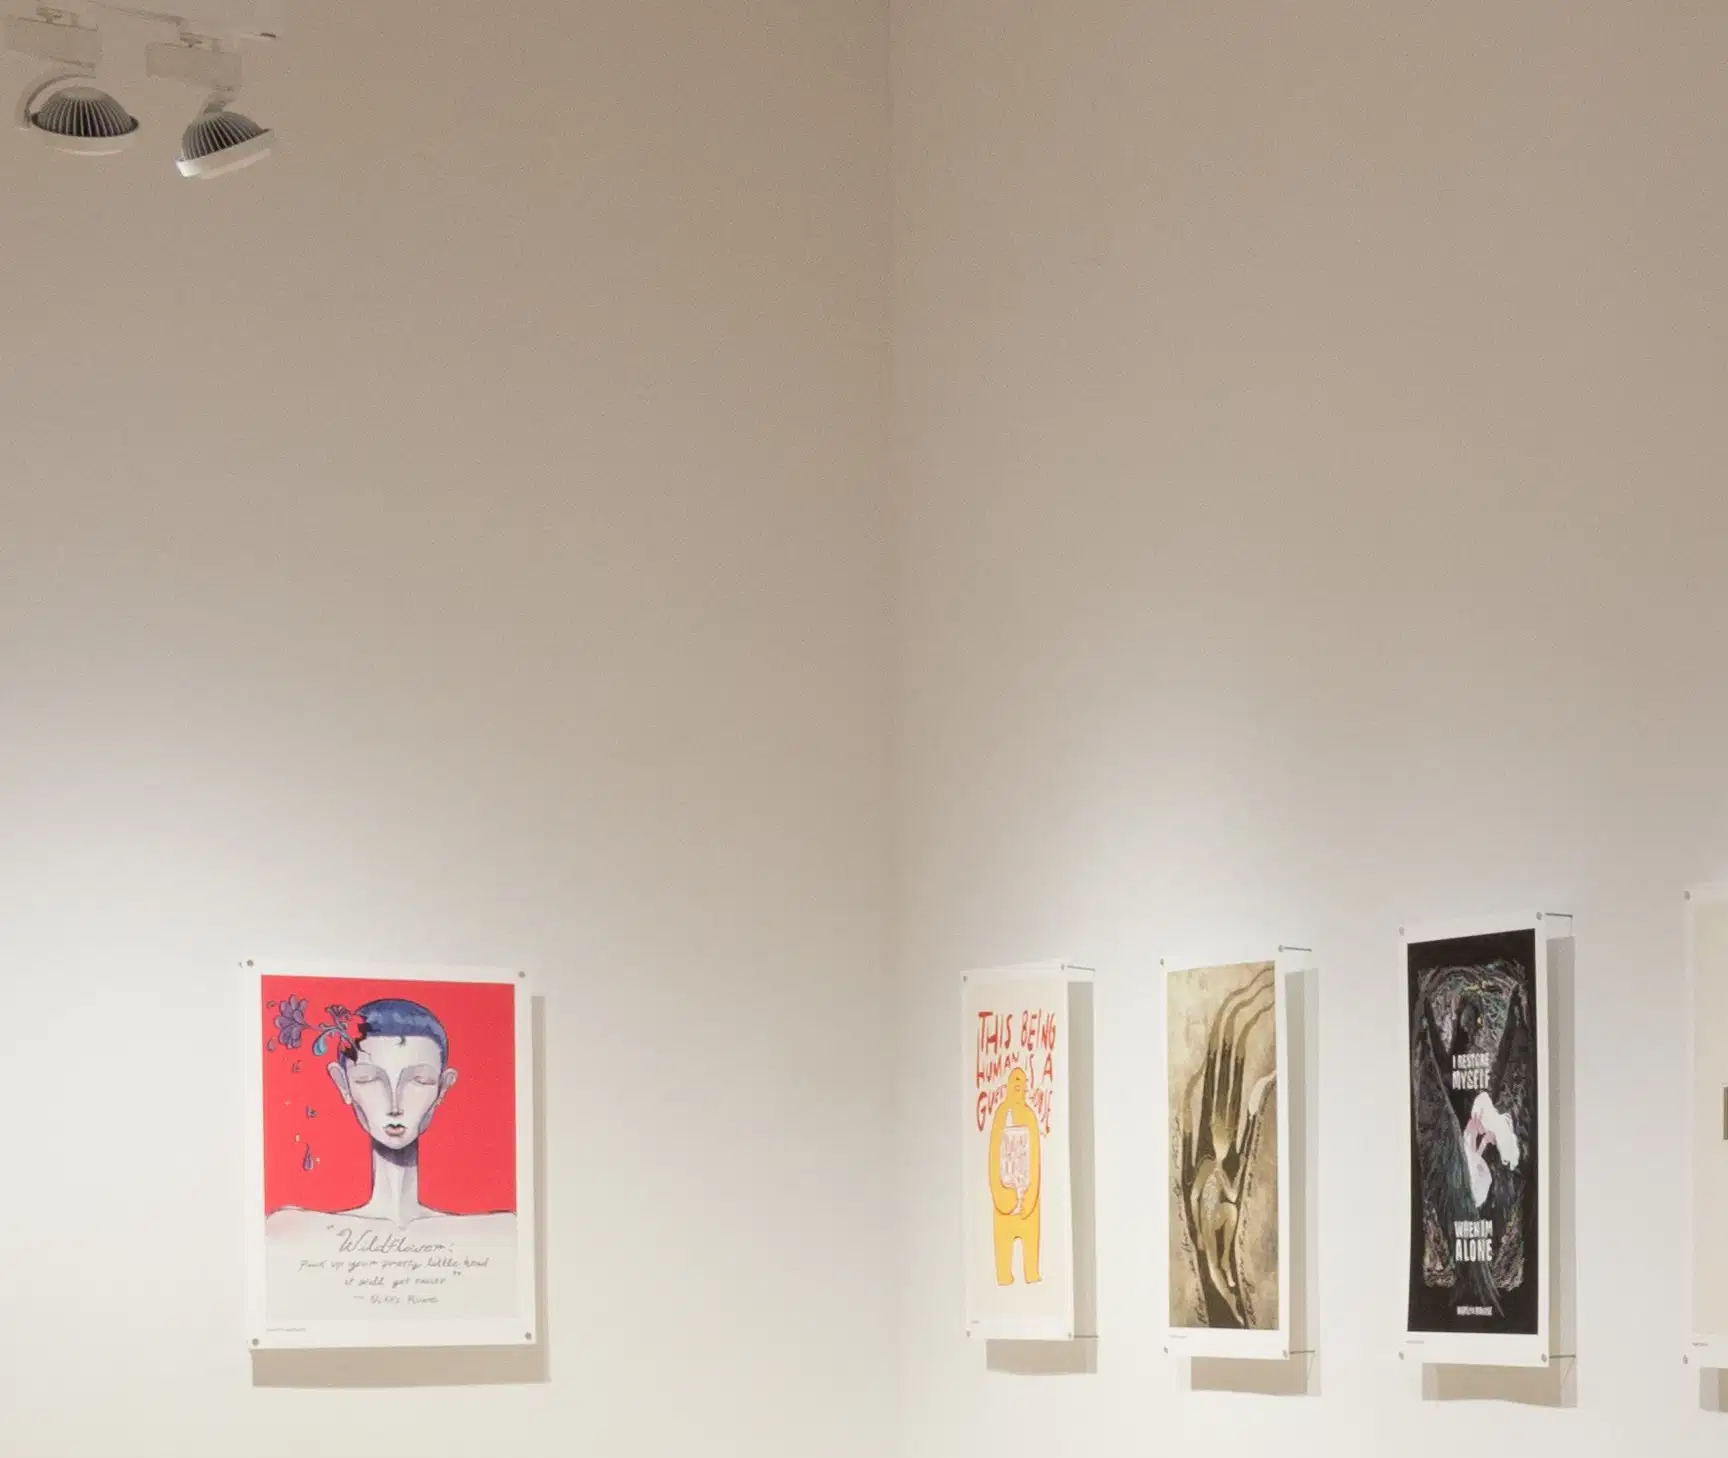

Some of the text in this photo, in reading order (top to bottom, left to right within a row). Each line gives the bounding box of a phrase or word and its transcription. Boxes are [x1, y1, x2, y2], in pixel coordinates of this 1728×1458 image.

[977, 1008, 1056, 1054] THIS BEING
[976, 1028, 1053, 1089] HUMAN IS A
[1452, 1054, 1456, 1069] I
[1452, 1069, 1490, 1090] MYSELF
[1455, 1238, 1493, 1262] ALONE
